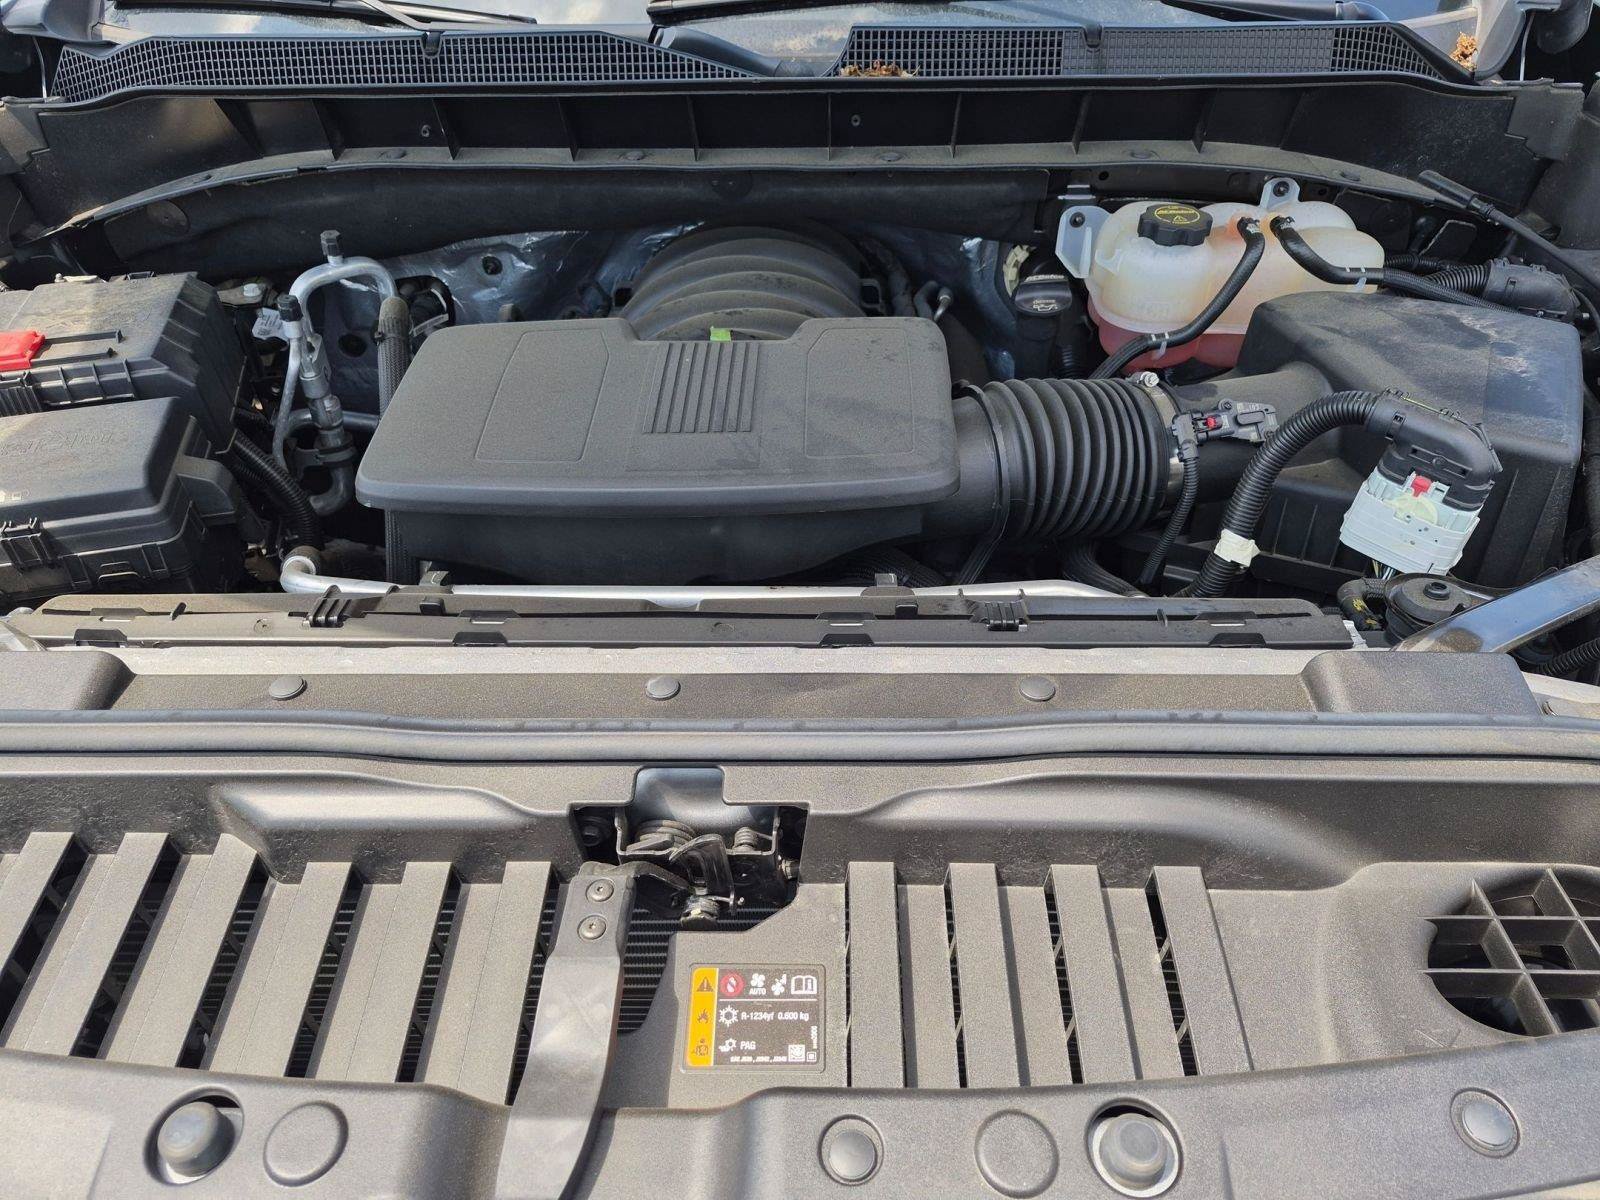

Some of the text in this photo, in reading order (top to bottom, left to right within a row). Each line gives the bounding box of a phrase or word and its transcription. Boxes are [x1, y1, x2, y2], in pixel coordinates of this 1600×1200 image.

[748, 987, 767, 996] AUTO
[741, 1011, 809, 1022] R-1234yf 0.600 kg
[740, 1040, 756, 1050] PAG
